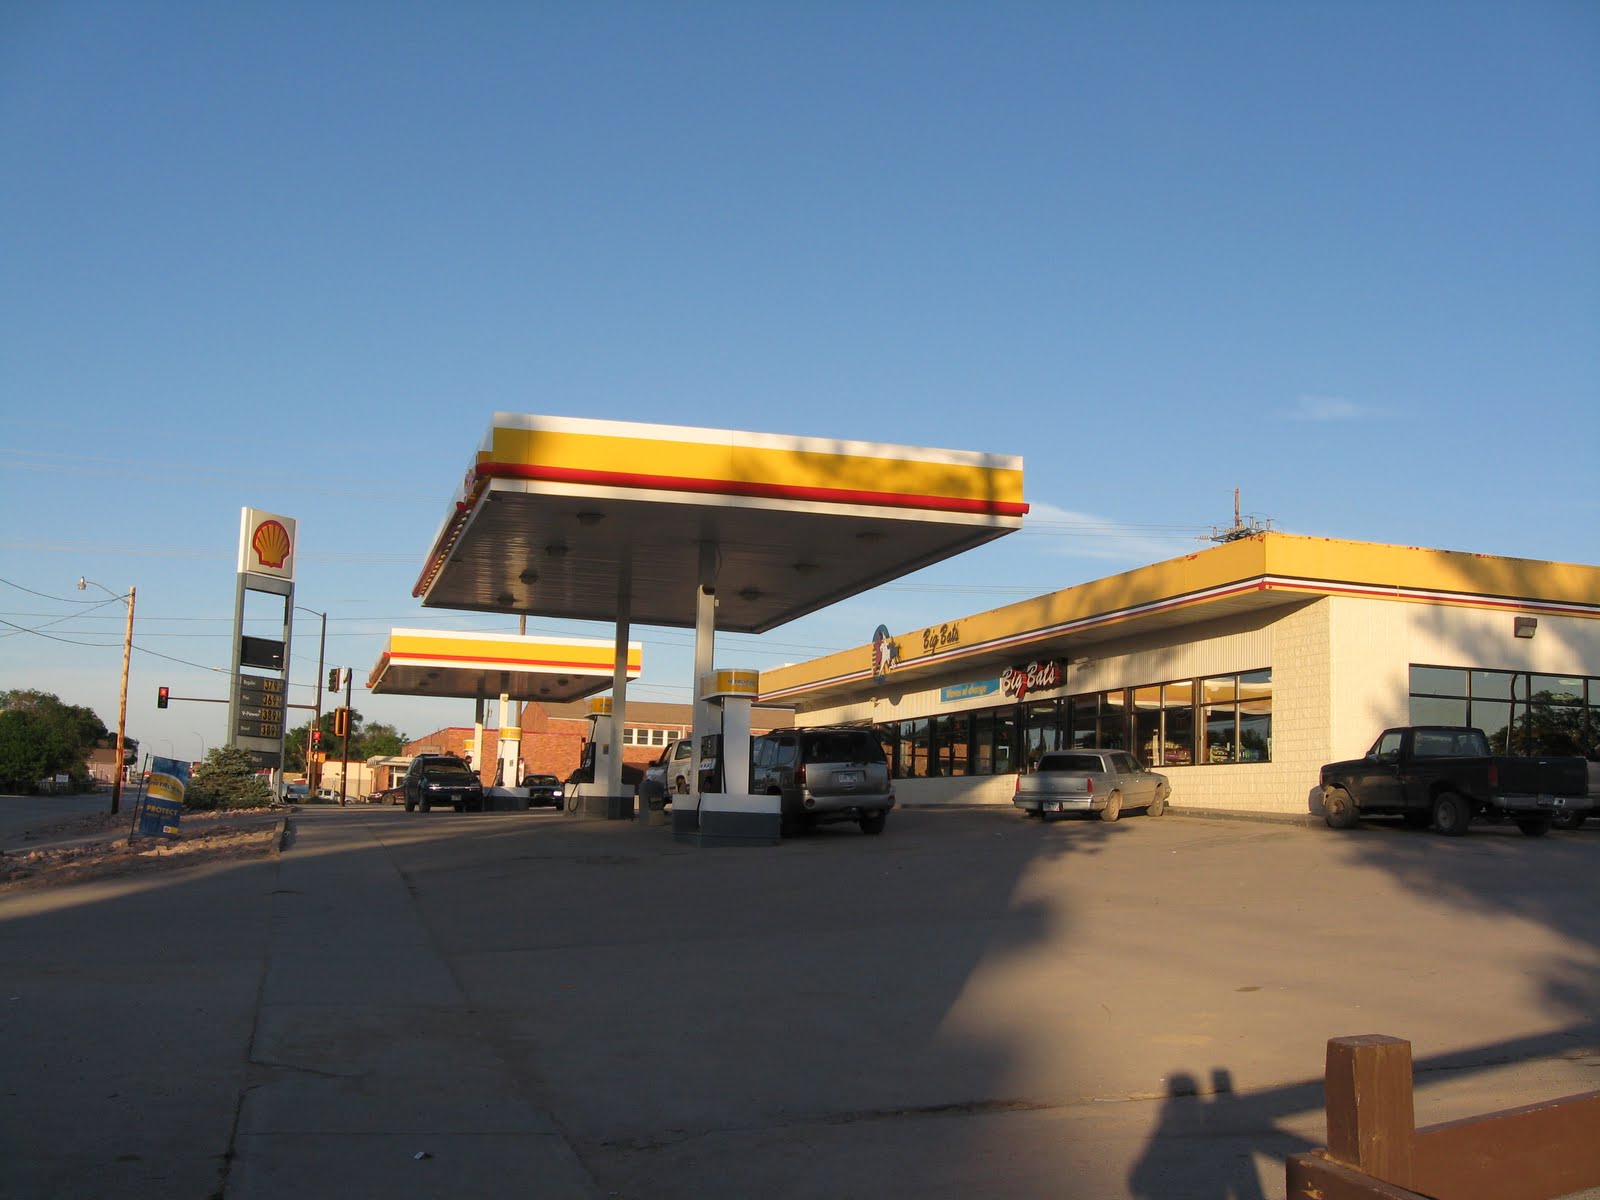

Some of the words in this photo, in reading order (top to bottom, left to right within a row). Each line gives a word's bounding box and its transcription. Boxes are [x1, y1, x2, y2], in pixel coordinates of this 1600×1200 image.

[923, 628, 939, 656] Big
[1002, 665, 1023, 697] Big
[1026, 661, 1055, 688] Bat's
[262, 694, 277, 705] 369
[262, 710, 277, 721] 389
[261, 725, 275, 736] 389
[146, 804, 177, 816] PROTECT
